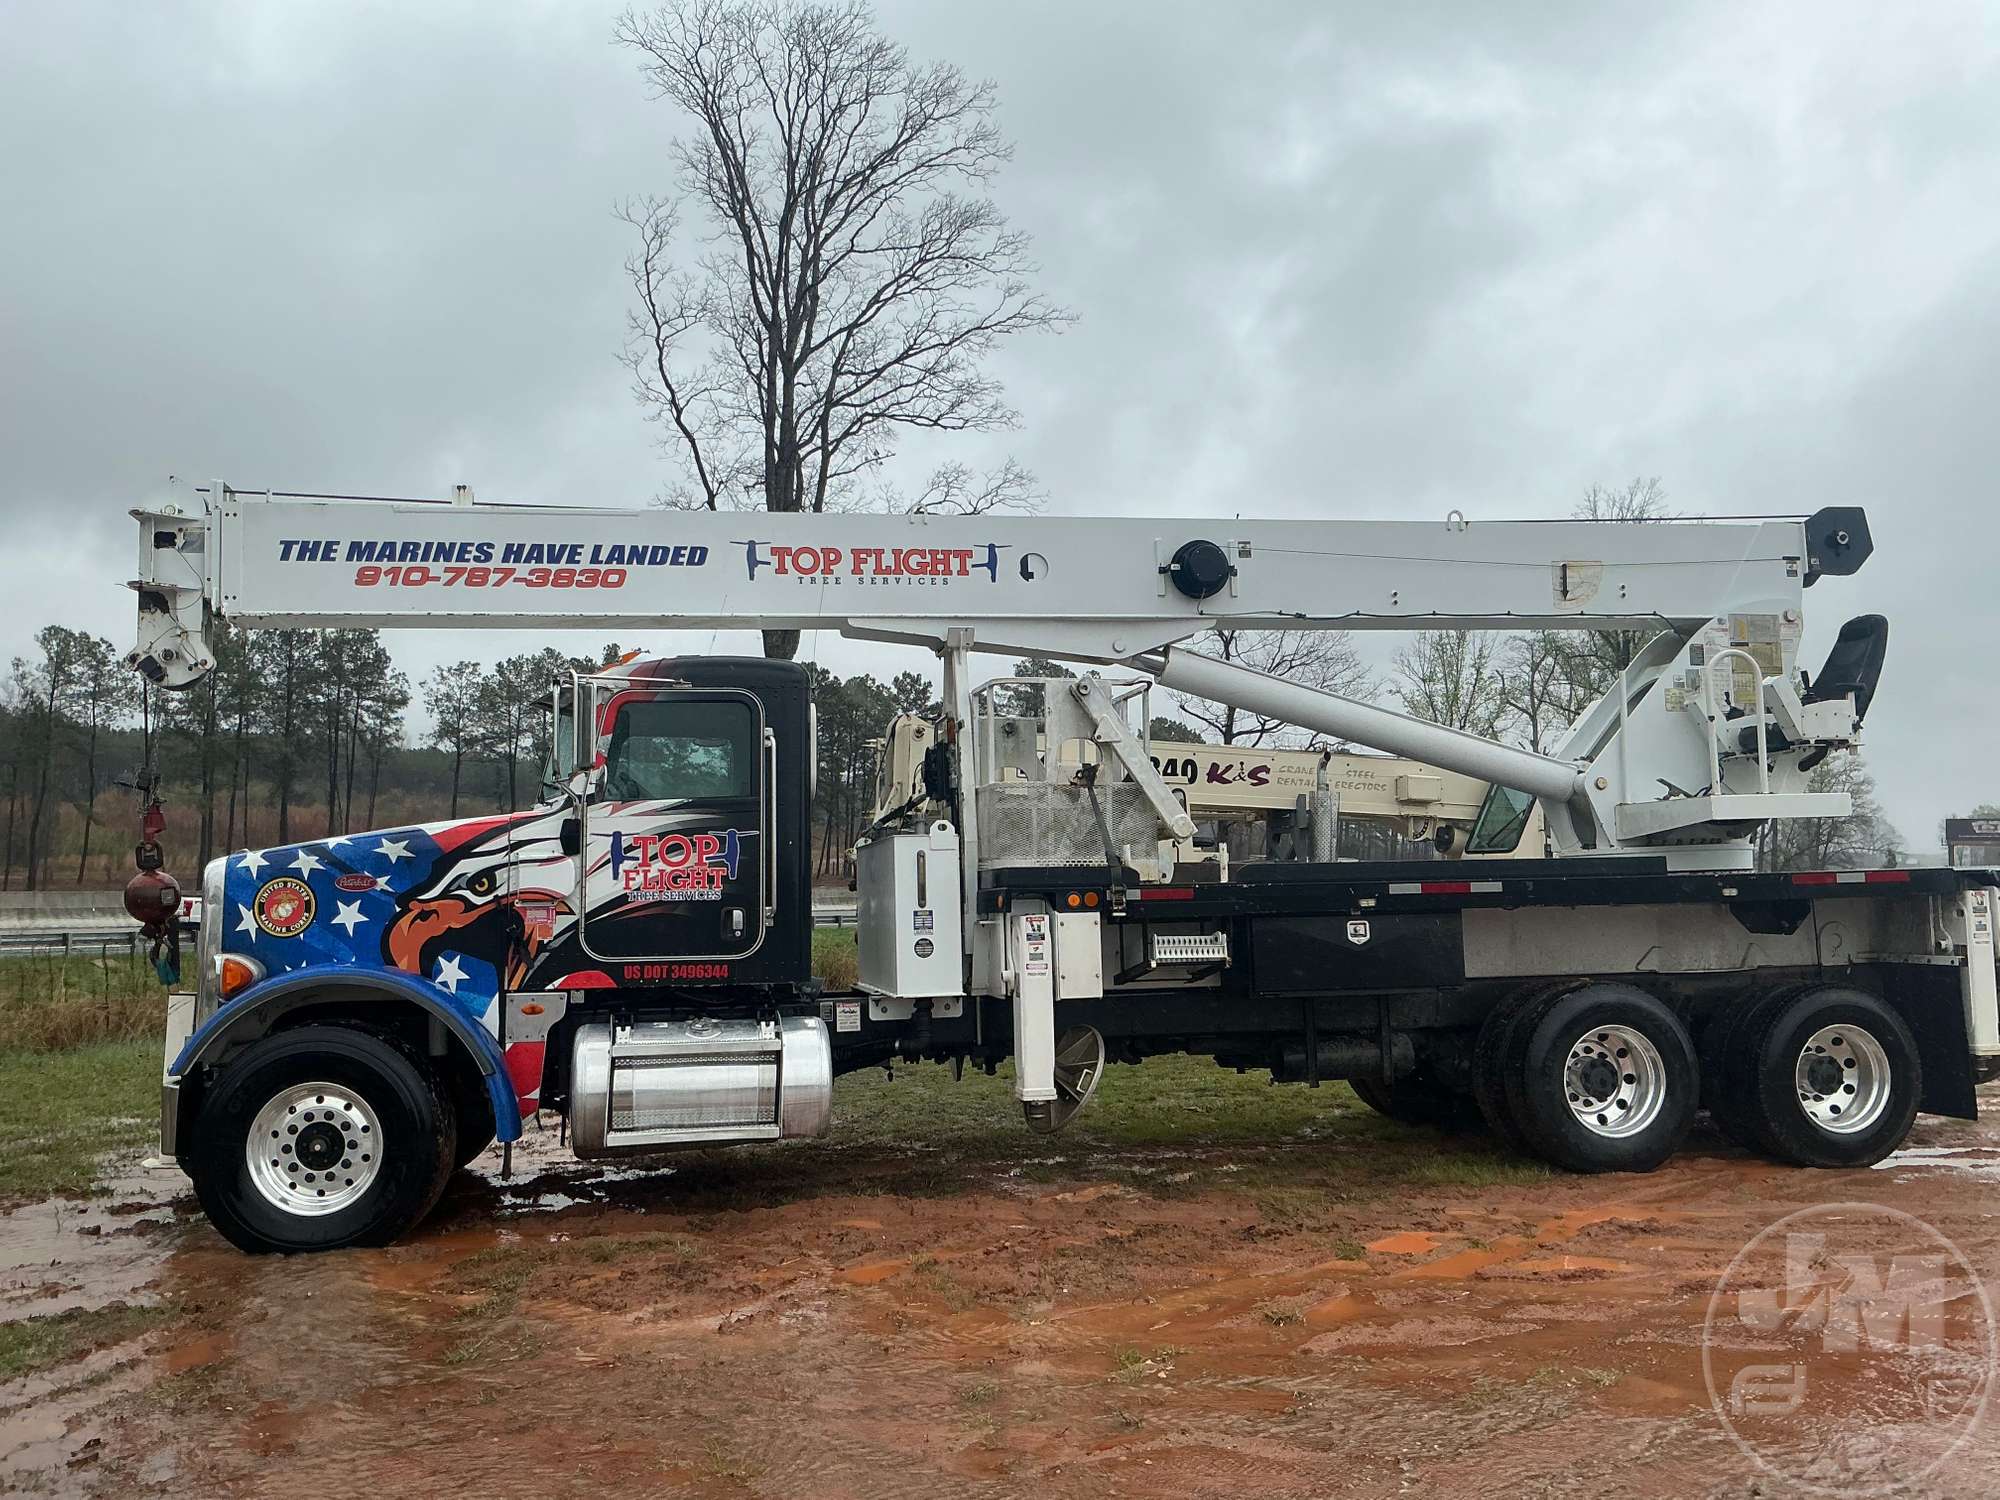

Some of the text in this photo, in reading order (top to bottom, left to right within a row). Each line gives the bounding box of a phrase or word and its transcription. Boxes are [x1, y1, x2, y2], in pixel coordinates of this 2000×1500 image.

[279, 540, 709, 567] THE MARINES HAVE LANDED
[770, 546, 974, 577] TOP FLIGHT
[354, 566, 627, 588] 910-787-3830
[798, 577, 951, 586] TREE SERVICES
[1150, 756, 1198, 784] 40
[1279, 765, 1315, 775] CRANE
[1346, 769, 1376, 779] STEEL
[1335, 780, 1387, 791] ERECTORS
[632, 835, 720, 868] TOP
[623, 868, 727, 891] FLIGHT
[260, 882, 310, 903] UNITED STATES
[628, 891, 722, 900] TREE SERVICES
[260, 912, 309, 932] MARINE CORPS
[624, 964, 729, 979] US DOT 3496344
